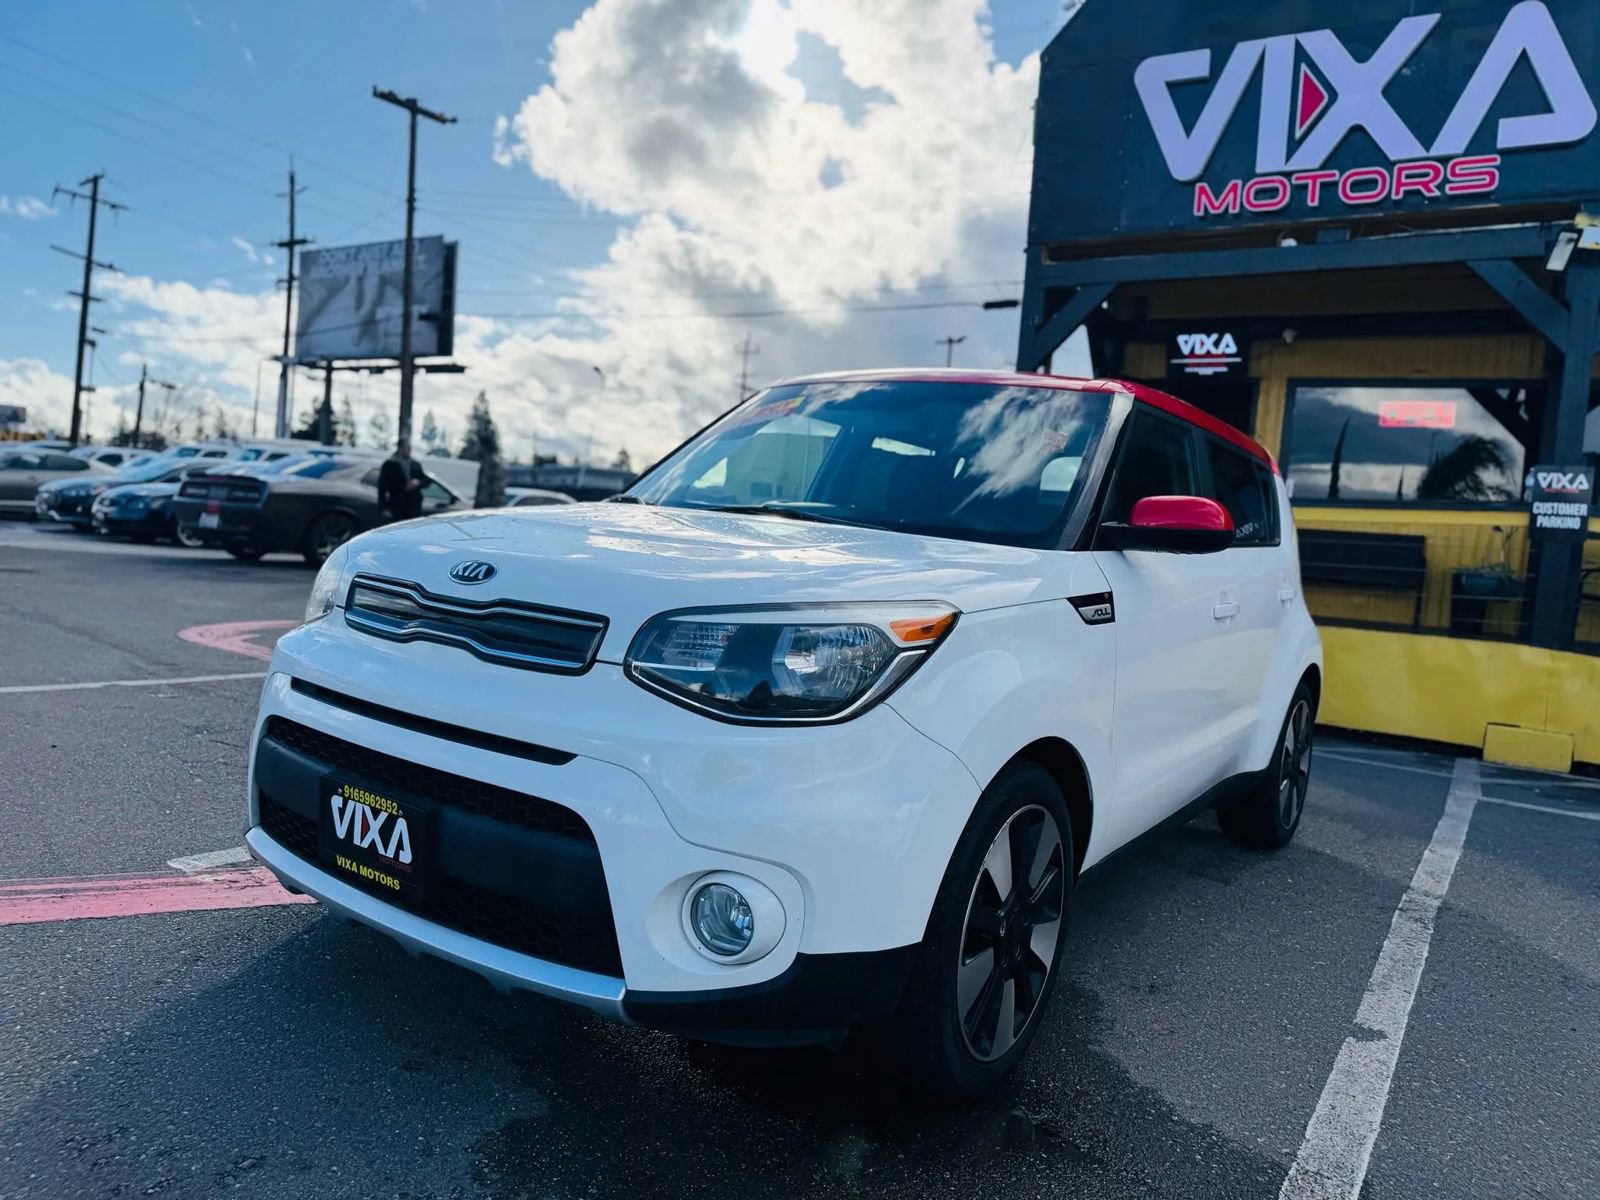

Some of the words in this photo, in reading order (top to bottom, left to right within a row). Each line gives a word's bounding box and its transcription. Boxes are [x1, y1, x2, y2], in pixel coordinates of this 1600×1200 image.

[1134, 0, 1598, 181] VIXA
[1194, 155, 1500, 216] MOTORS
[1177, 332, 1238, 355] VIXA
[1537, 472, 1589, 490] VIXA
[1532, 501, 1588, 517] CUSTOMER
[1536, 515, 1581, 530] PARKING
[453, 561, 489, 579] KIA
[344, 784, 398, 815] 9165962952
[330, 794, 413, 864] VIXA
[336, 854, 358, 873] VIXA
[359, 864, 401, 890] MOTORS
